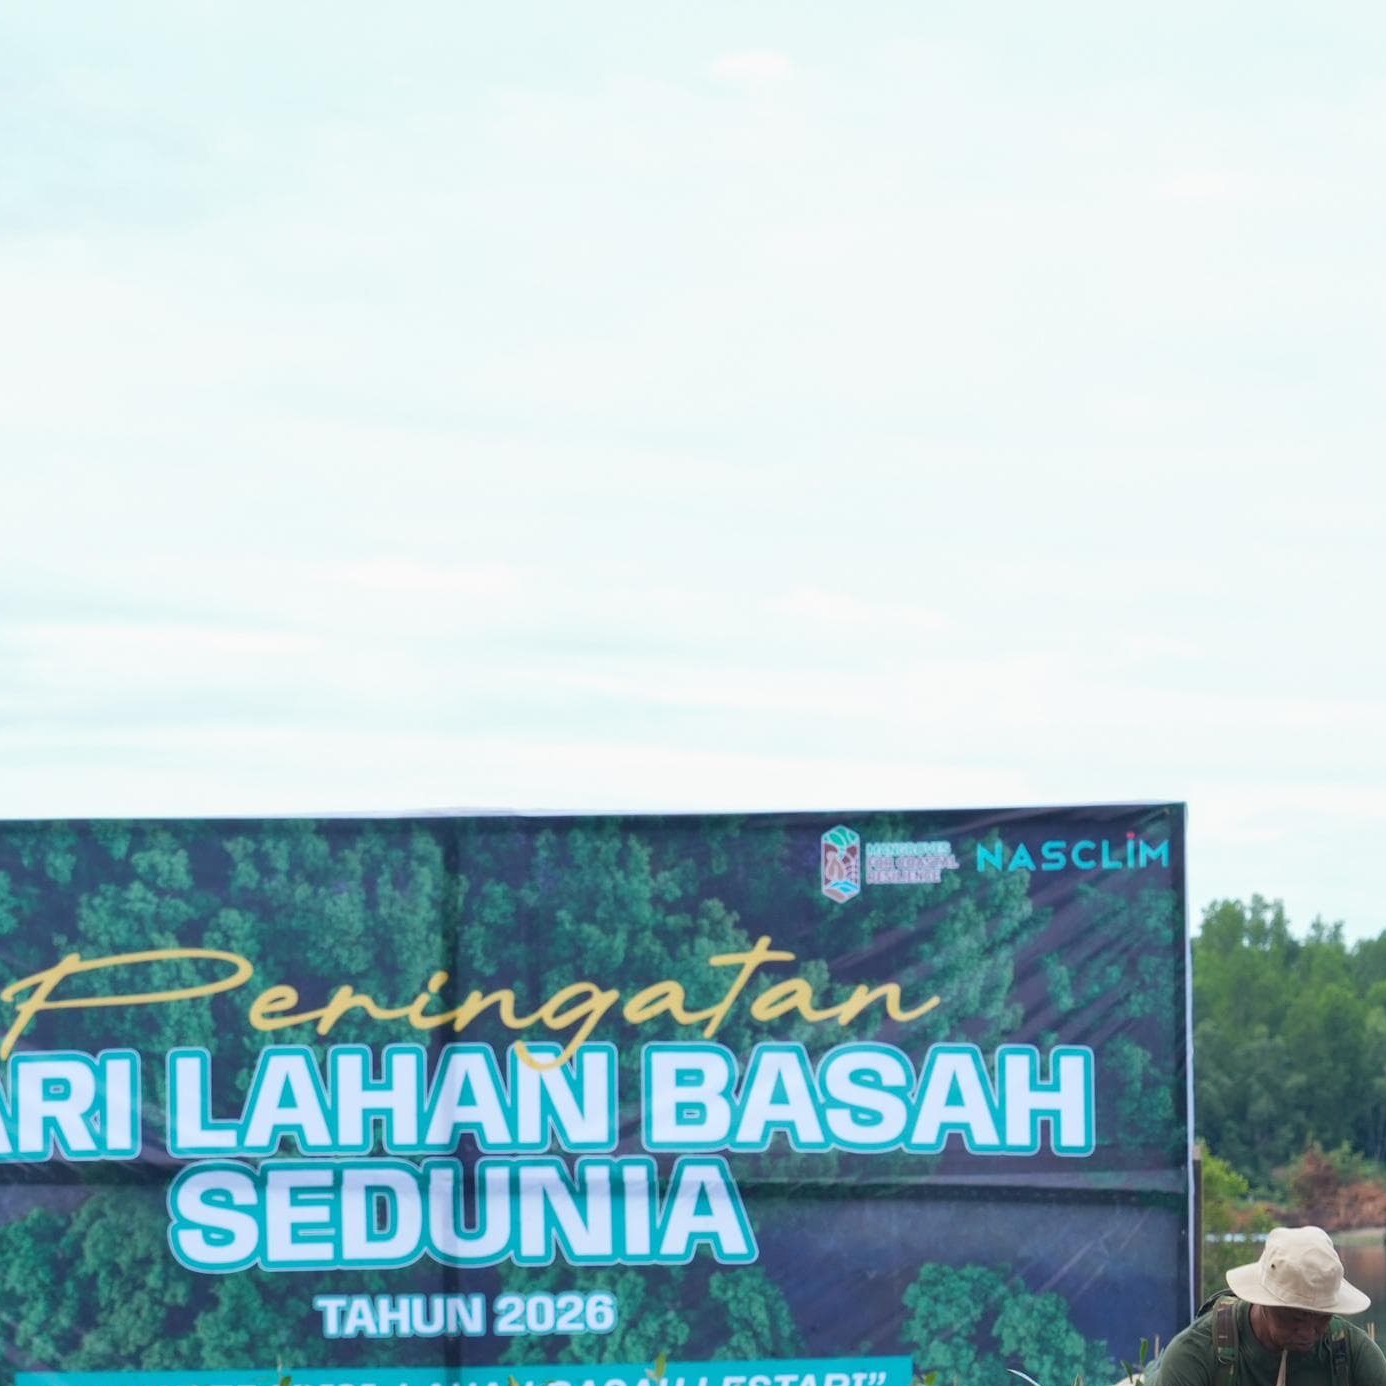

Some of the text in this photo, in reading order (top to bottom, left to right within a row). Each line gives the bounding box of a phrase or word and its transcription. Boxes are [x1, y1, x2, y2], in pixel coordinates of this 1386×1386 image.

[976, 832, 1169, 872] NASCLIM
[0, 934, 941, 1070] Peringatan
[167, 1043, 618, 1157] LAHAN
[642, 1042, 1096, 1157] BASAH
[168, 1155, 758, 1272] SEDUNIA
[314, 1290, 617, 1339] TAHUN 2026
